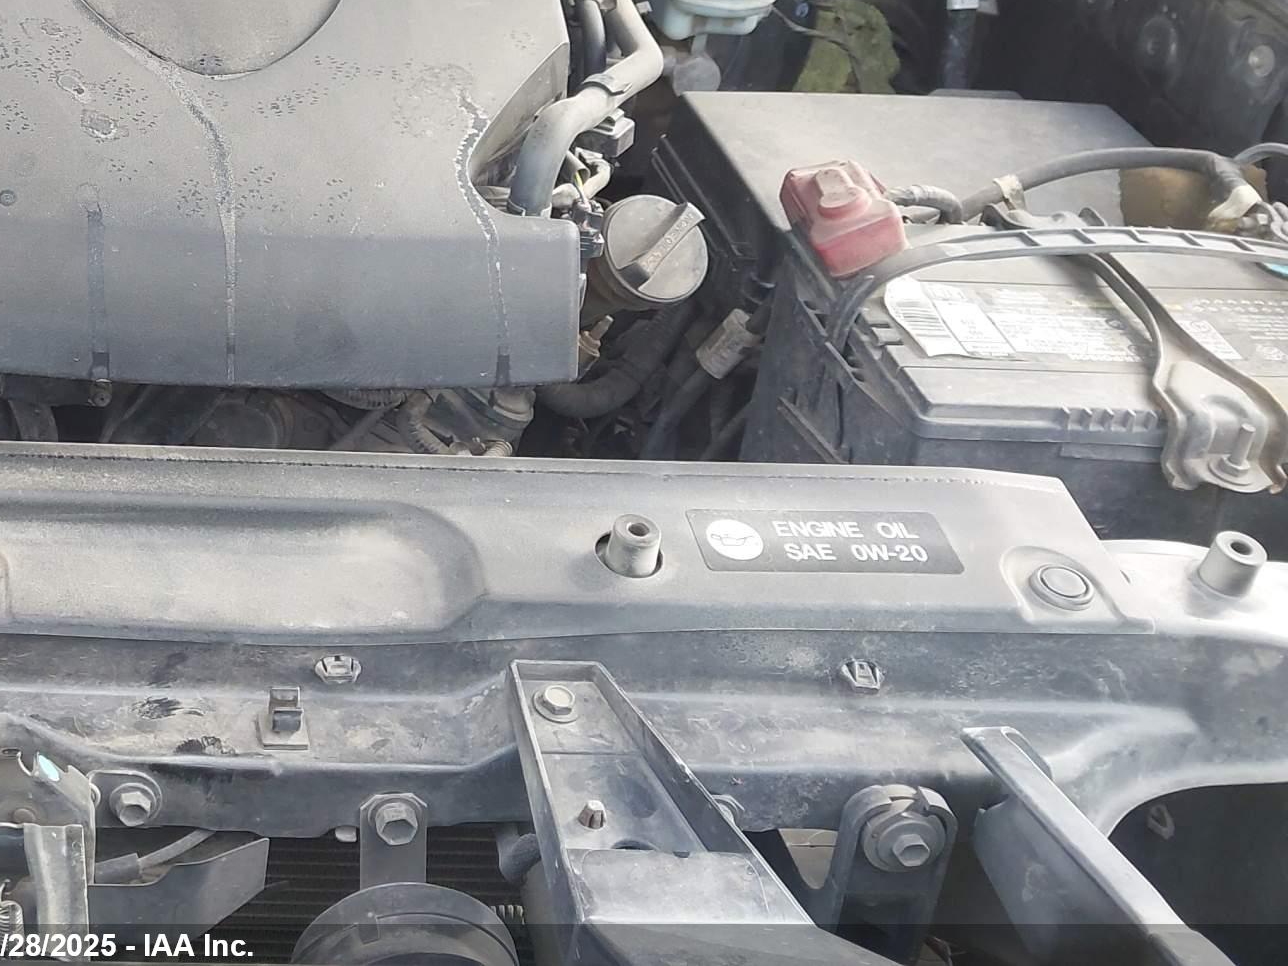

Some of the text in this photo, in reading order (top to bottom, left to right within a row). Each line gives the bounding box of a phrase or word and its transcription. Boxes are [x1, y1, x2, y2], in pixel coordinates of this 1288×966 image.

[771, 520, 919, 539] ENGINE OIL
[783, 543, 928, 563] SAE 0W-20
